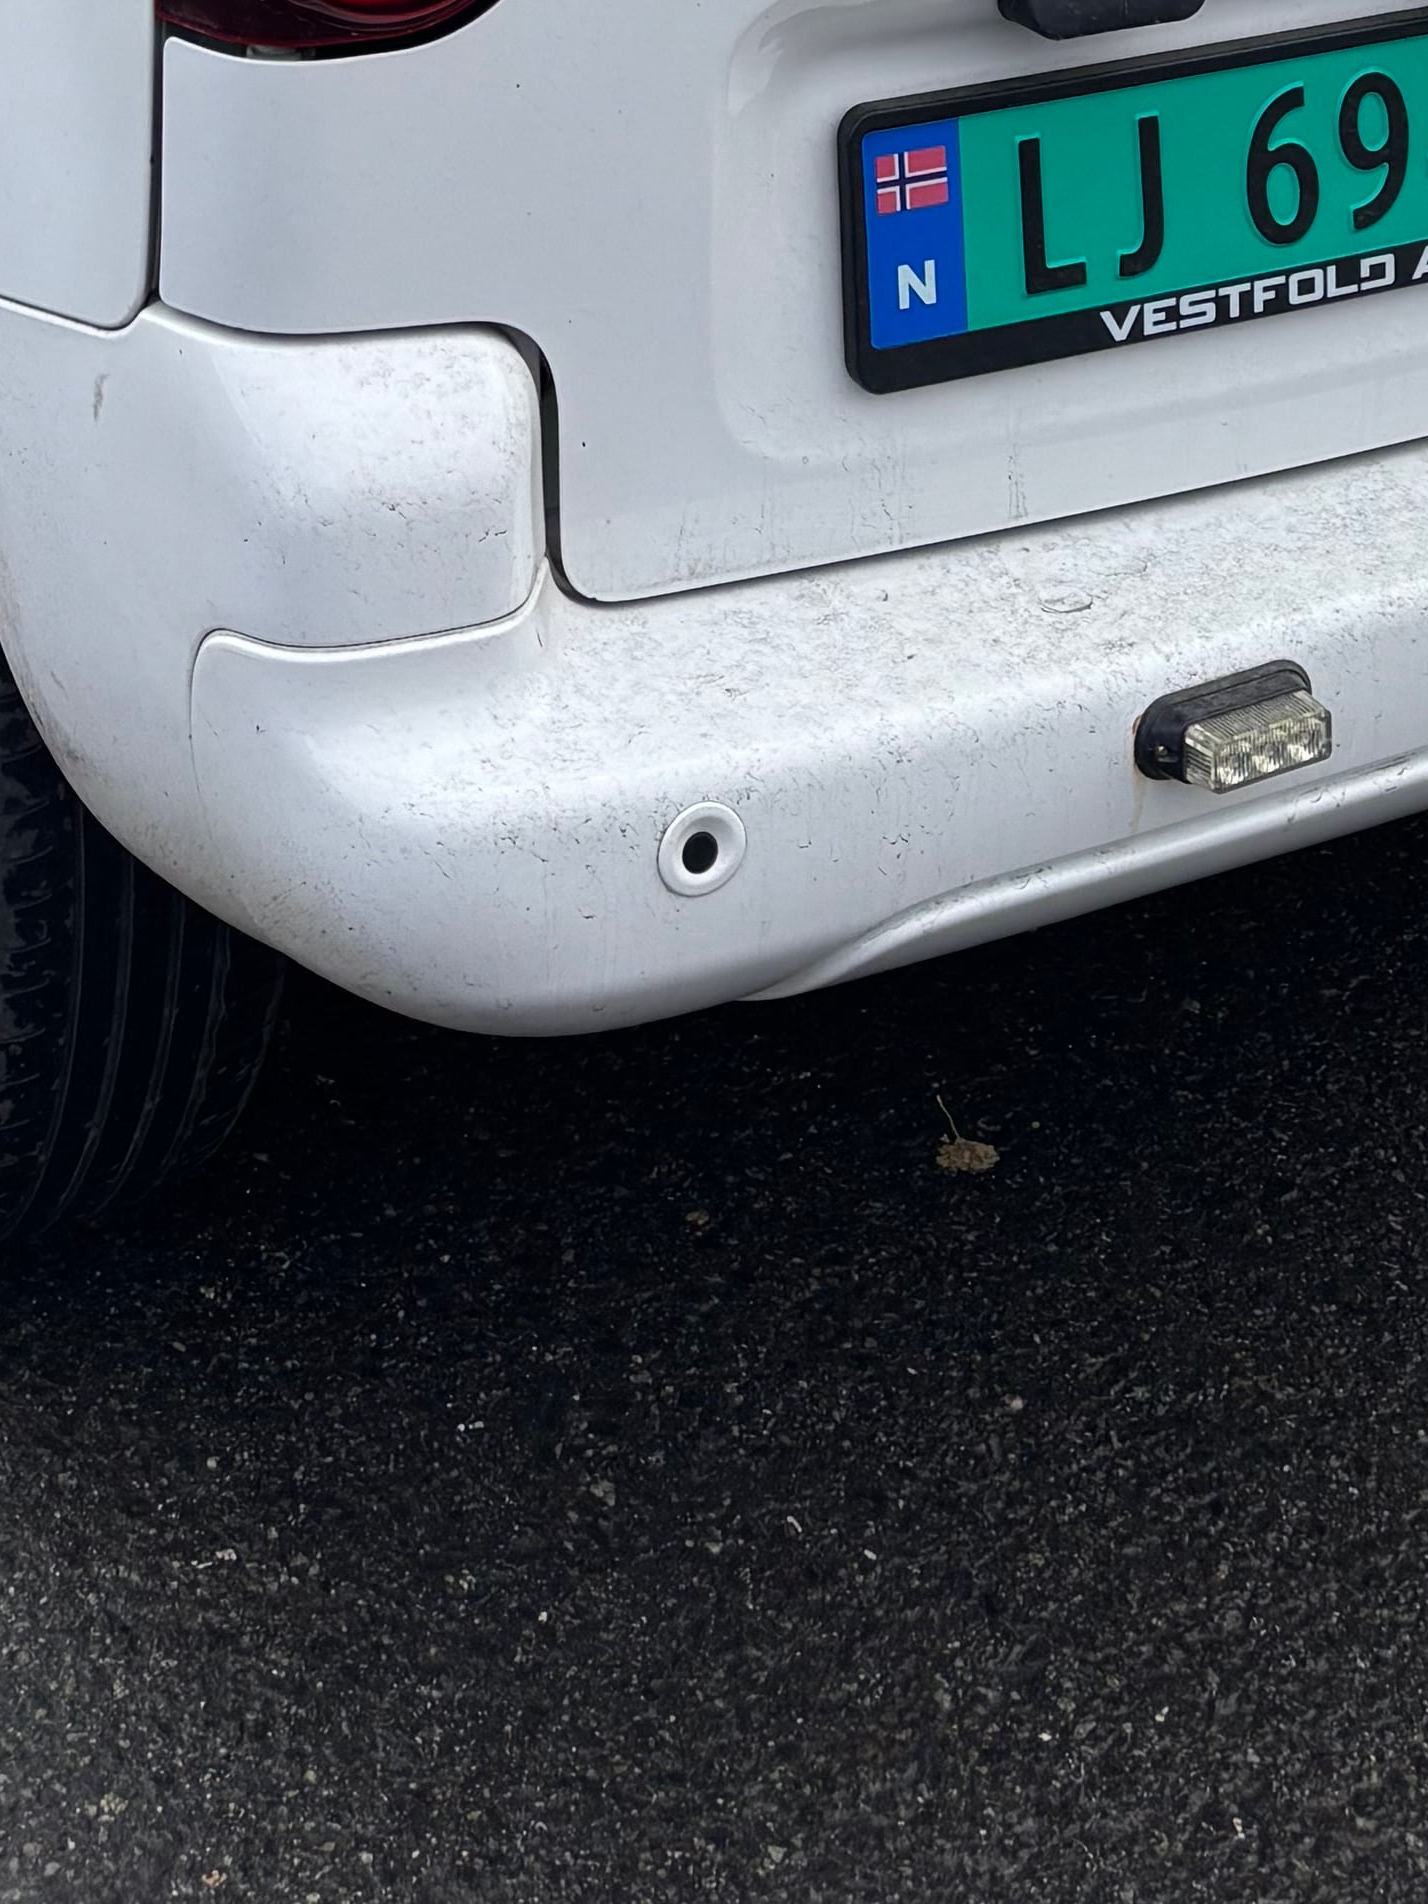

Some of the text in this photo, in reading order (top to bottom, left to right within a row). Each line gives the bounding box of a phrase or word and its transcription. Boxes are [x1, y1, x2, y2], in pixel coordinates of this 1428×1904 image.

[1016, 113, 1164, 296] LJ
[897, 257, 938, 310] N
[1098, 258, 1399, 342] VESTFOLD
